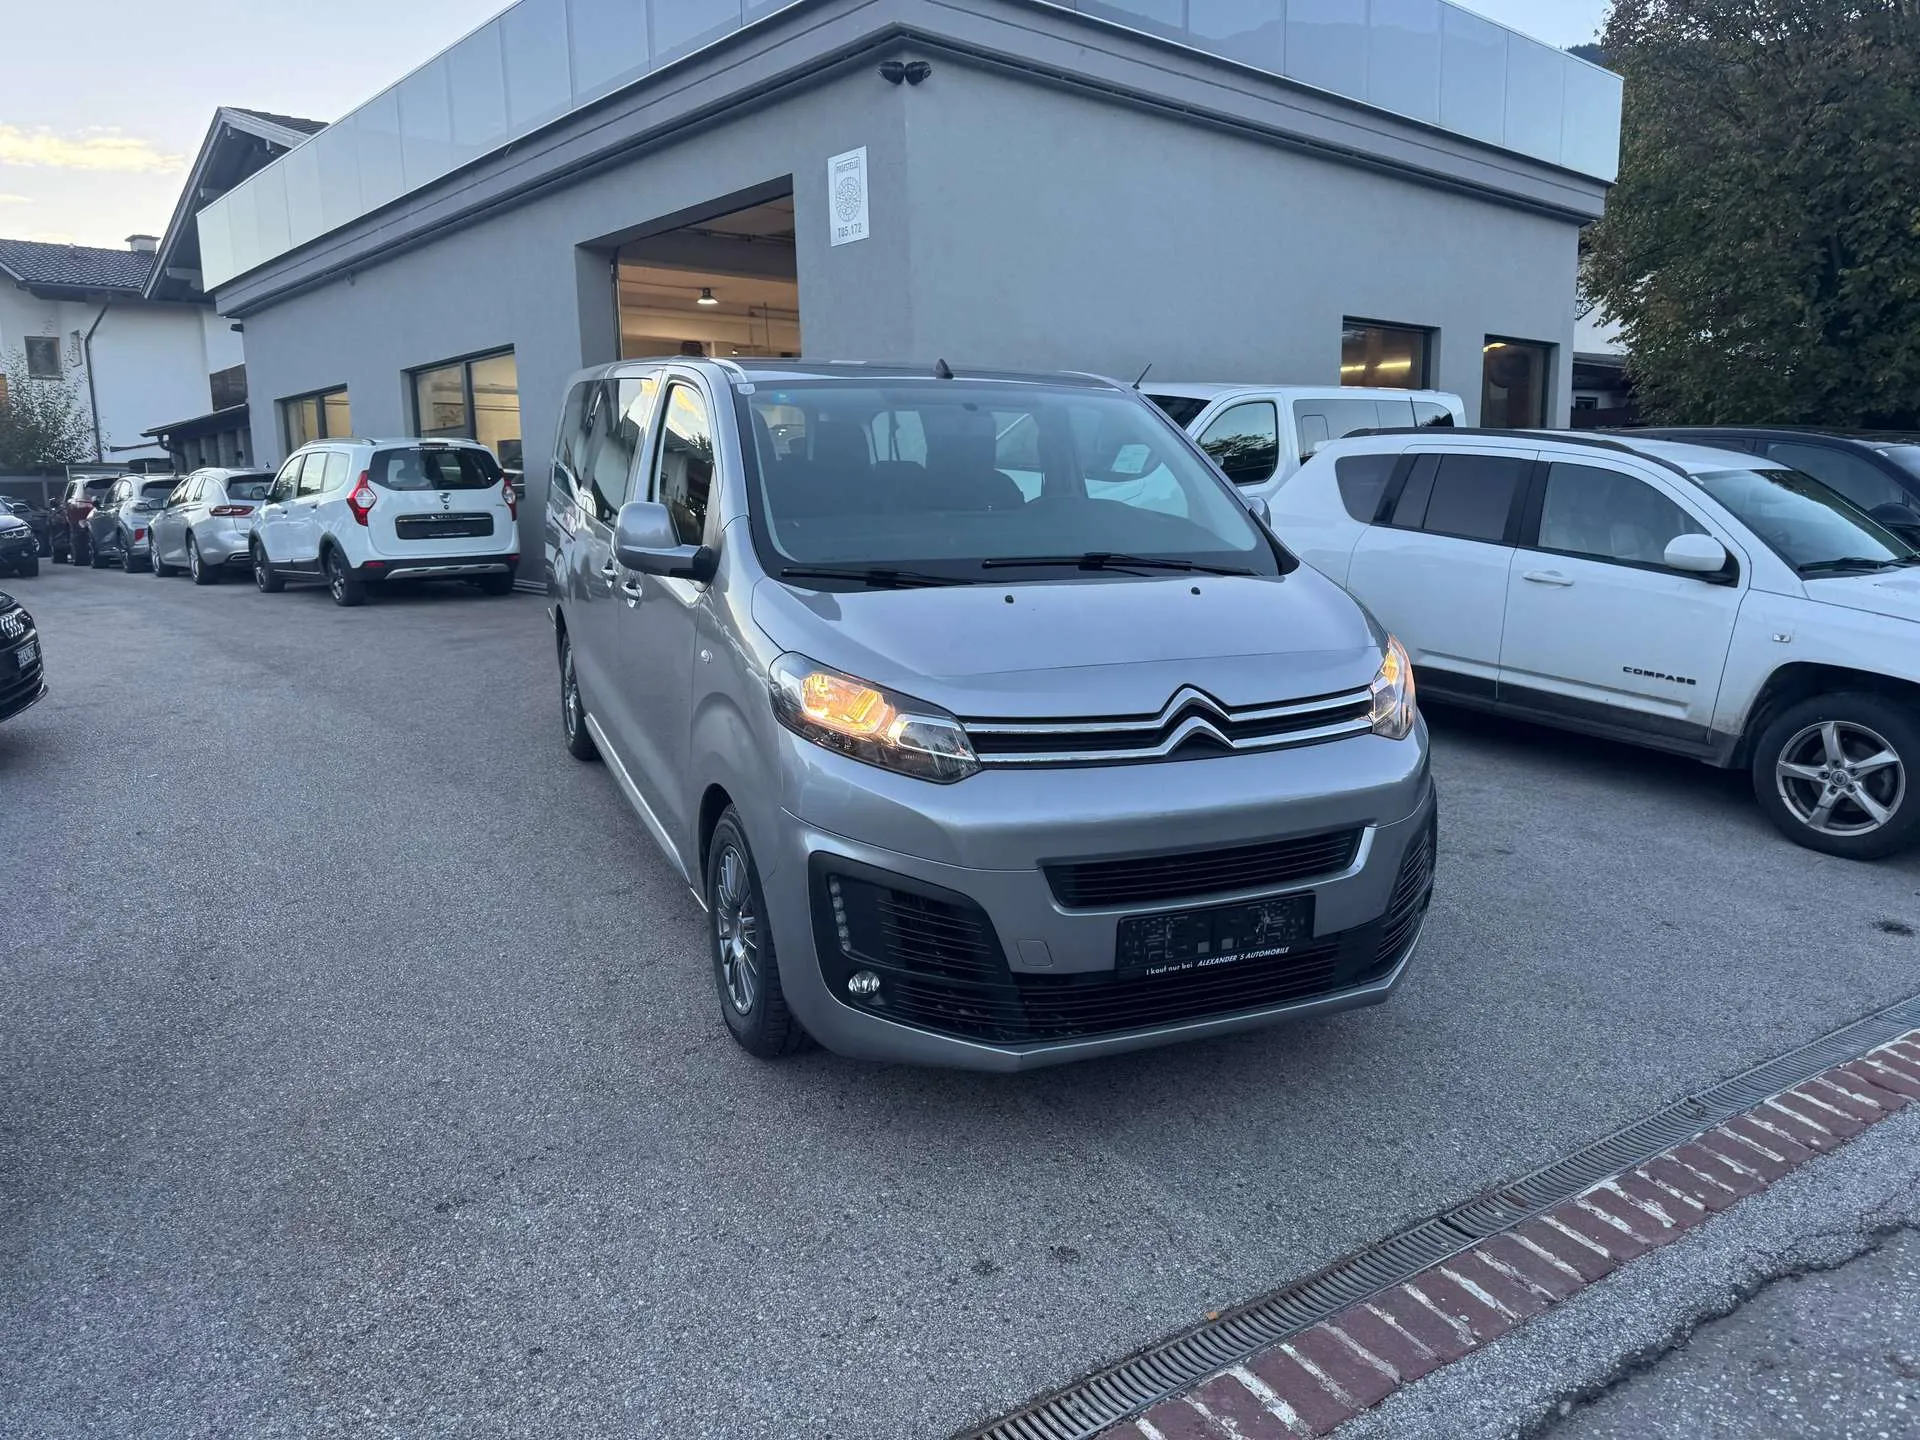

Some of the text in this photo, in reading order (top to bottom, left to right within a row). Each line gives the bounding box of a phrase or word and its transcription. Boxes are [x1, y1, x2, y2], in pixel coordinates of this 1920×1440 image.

[1623, 666, 1697, 686] COMPASS
[1169, 964, 1180, 972] nur
[1181, 961, 1193, 970] bei
[1197, 956, 1237, 967] ALEXANDER
[1246, 947, 1290, 960] AUTOMOBILE
